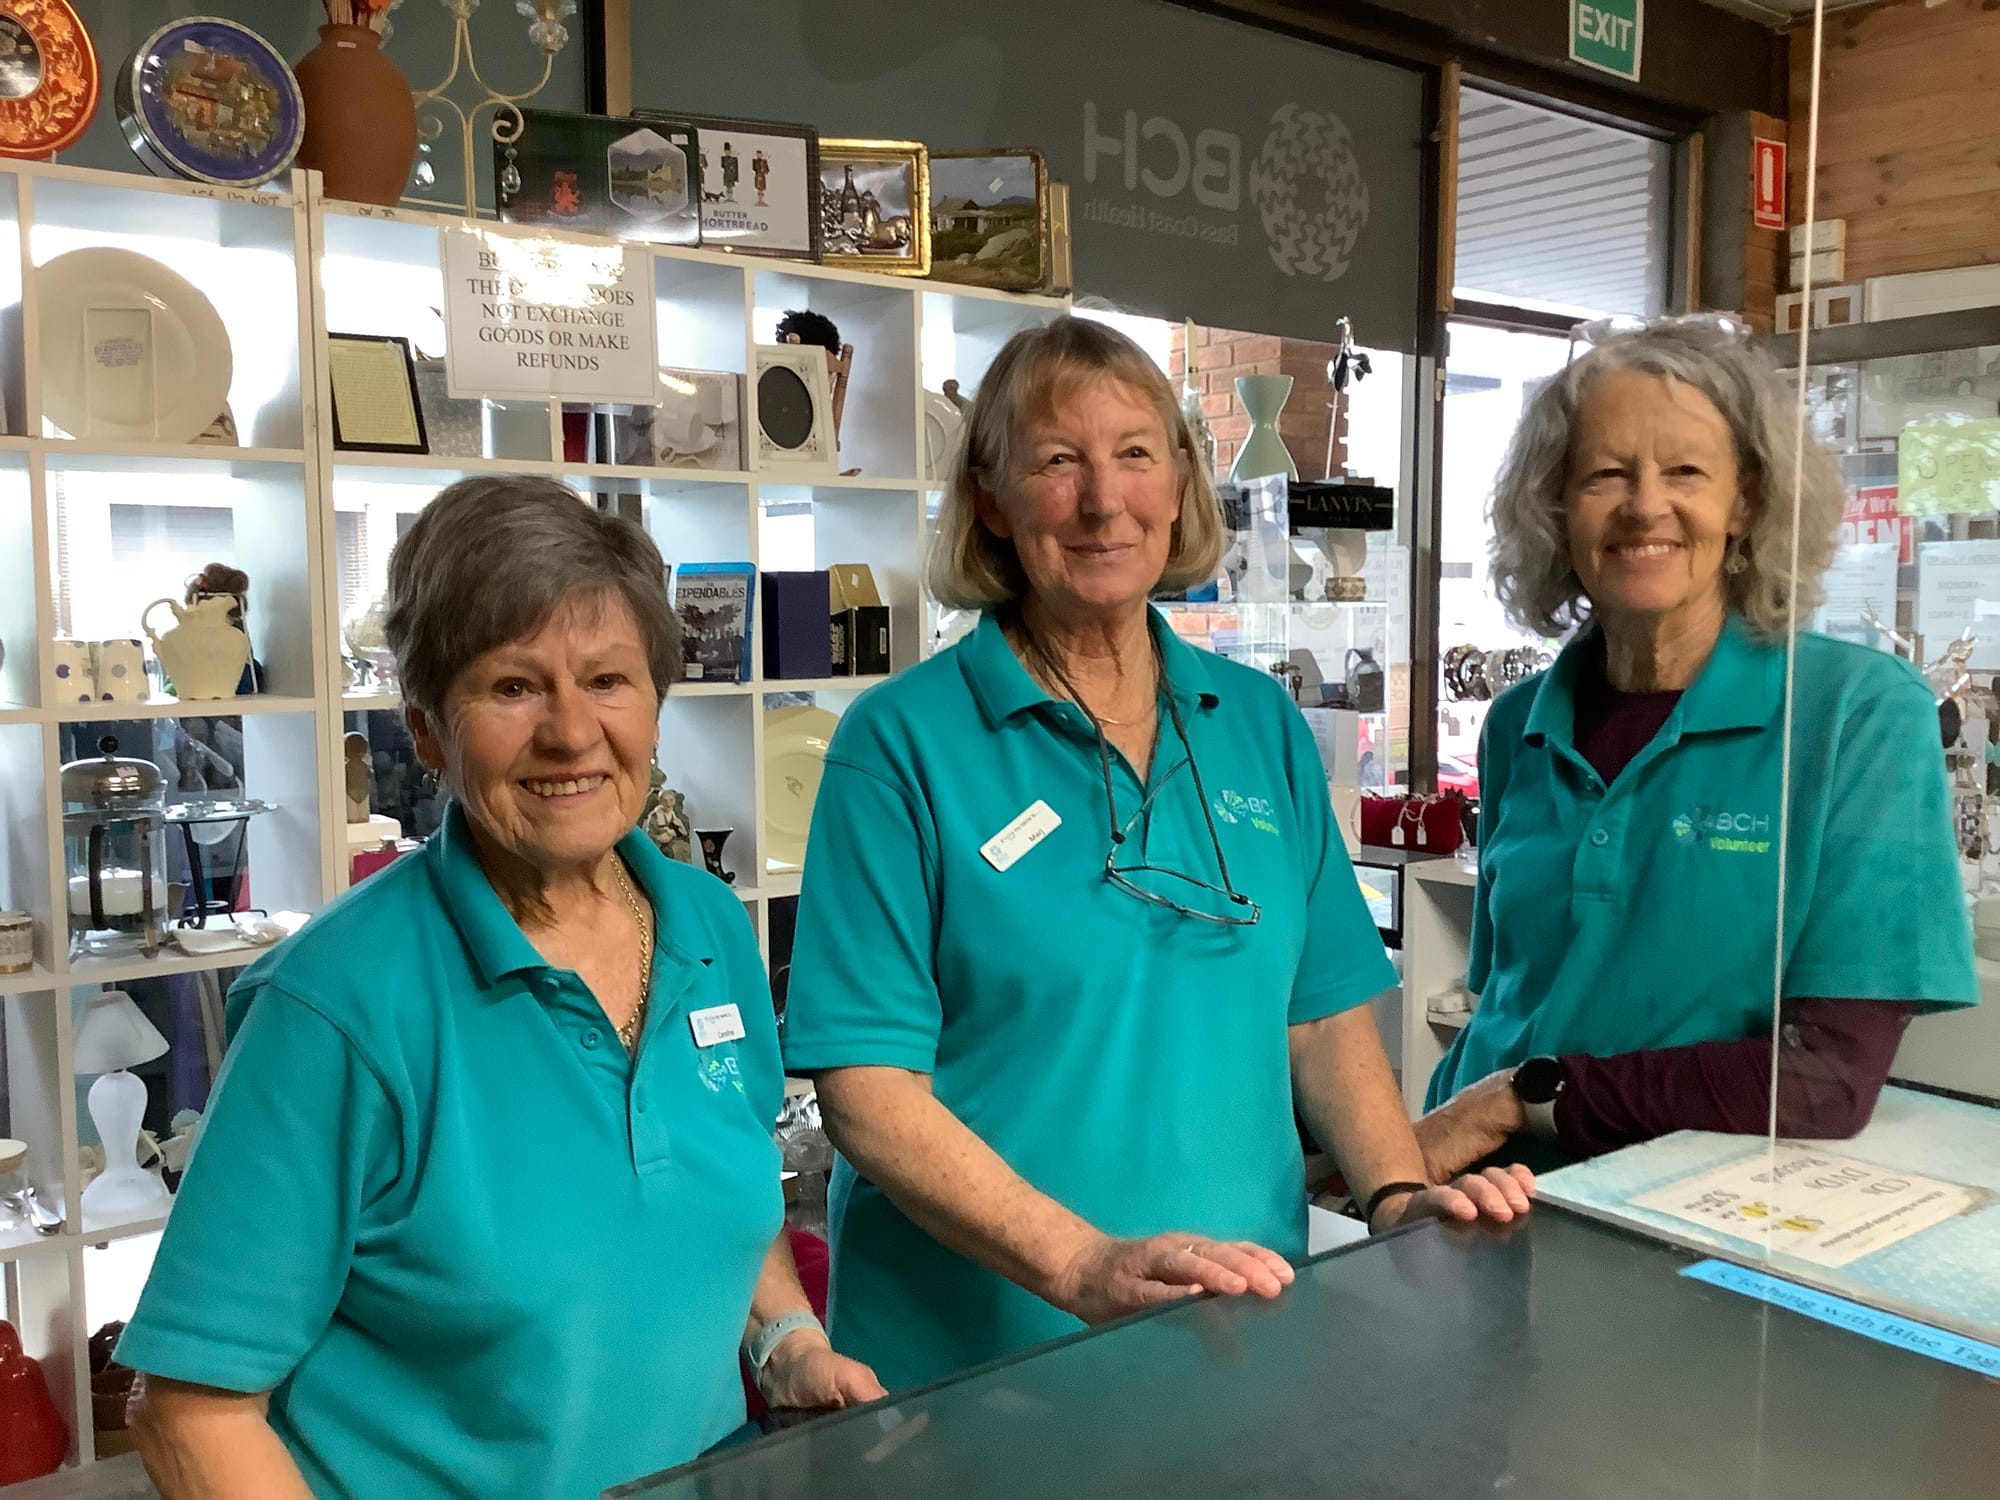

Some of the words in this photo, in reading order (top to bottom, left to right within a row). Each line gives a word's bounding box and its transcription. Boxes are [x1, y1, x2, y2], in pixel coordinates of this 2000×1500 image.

[1579, 3, 1633, 52] EXIT
[703, 217, 769, 231] HORTBREAD
[713, 210, 748, 219] BUTTER
[467, 278, 504, 296] THE
[482, 303, 521, 320] NOT
[527, 306, 625, 328] EXCHANGE
[479, 327, 544, 345] GOODS
[549, 331, 574, 347] OR
[579, 333, 630, 351] MAKE
[517, 352, 600, 371] REFUNDS
[1307, 495, 1373, 513] LANVIN
[1838, 518, 1899, 545] PEN
[677, 587, 745, 599] EXPENDABLES
[1248, 797, 1275, 816] BC
[1716, 812, 1769, 832] BCH
[1711, 837, 1770, 852] Volunteer
[1803, 1167, 1870, 1189] DVDs
[1859, 1177, 1912, 1195] CDs
[1823, 1304, 1875, 1329] with
[1882, 1324, 1942, 1348] Blue
